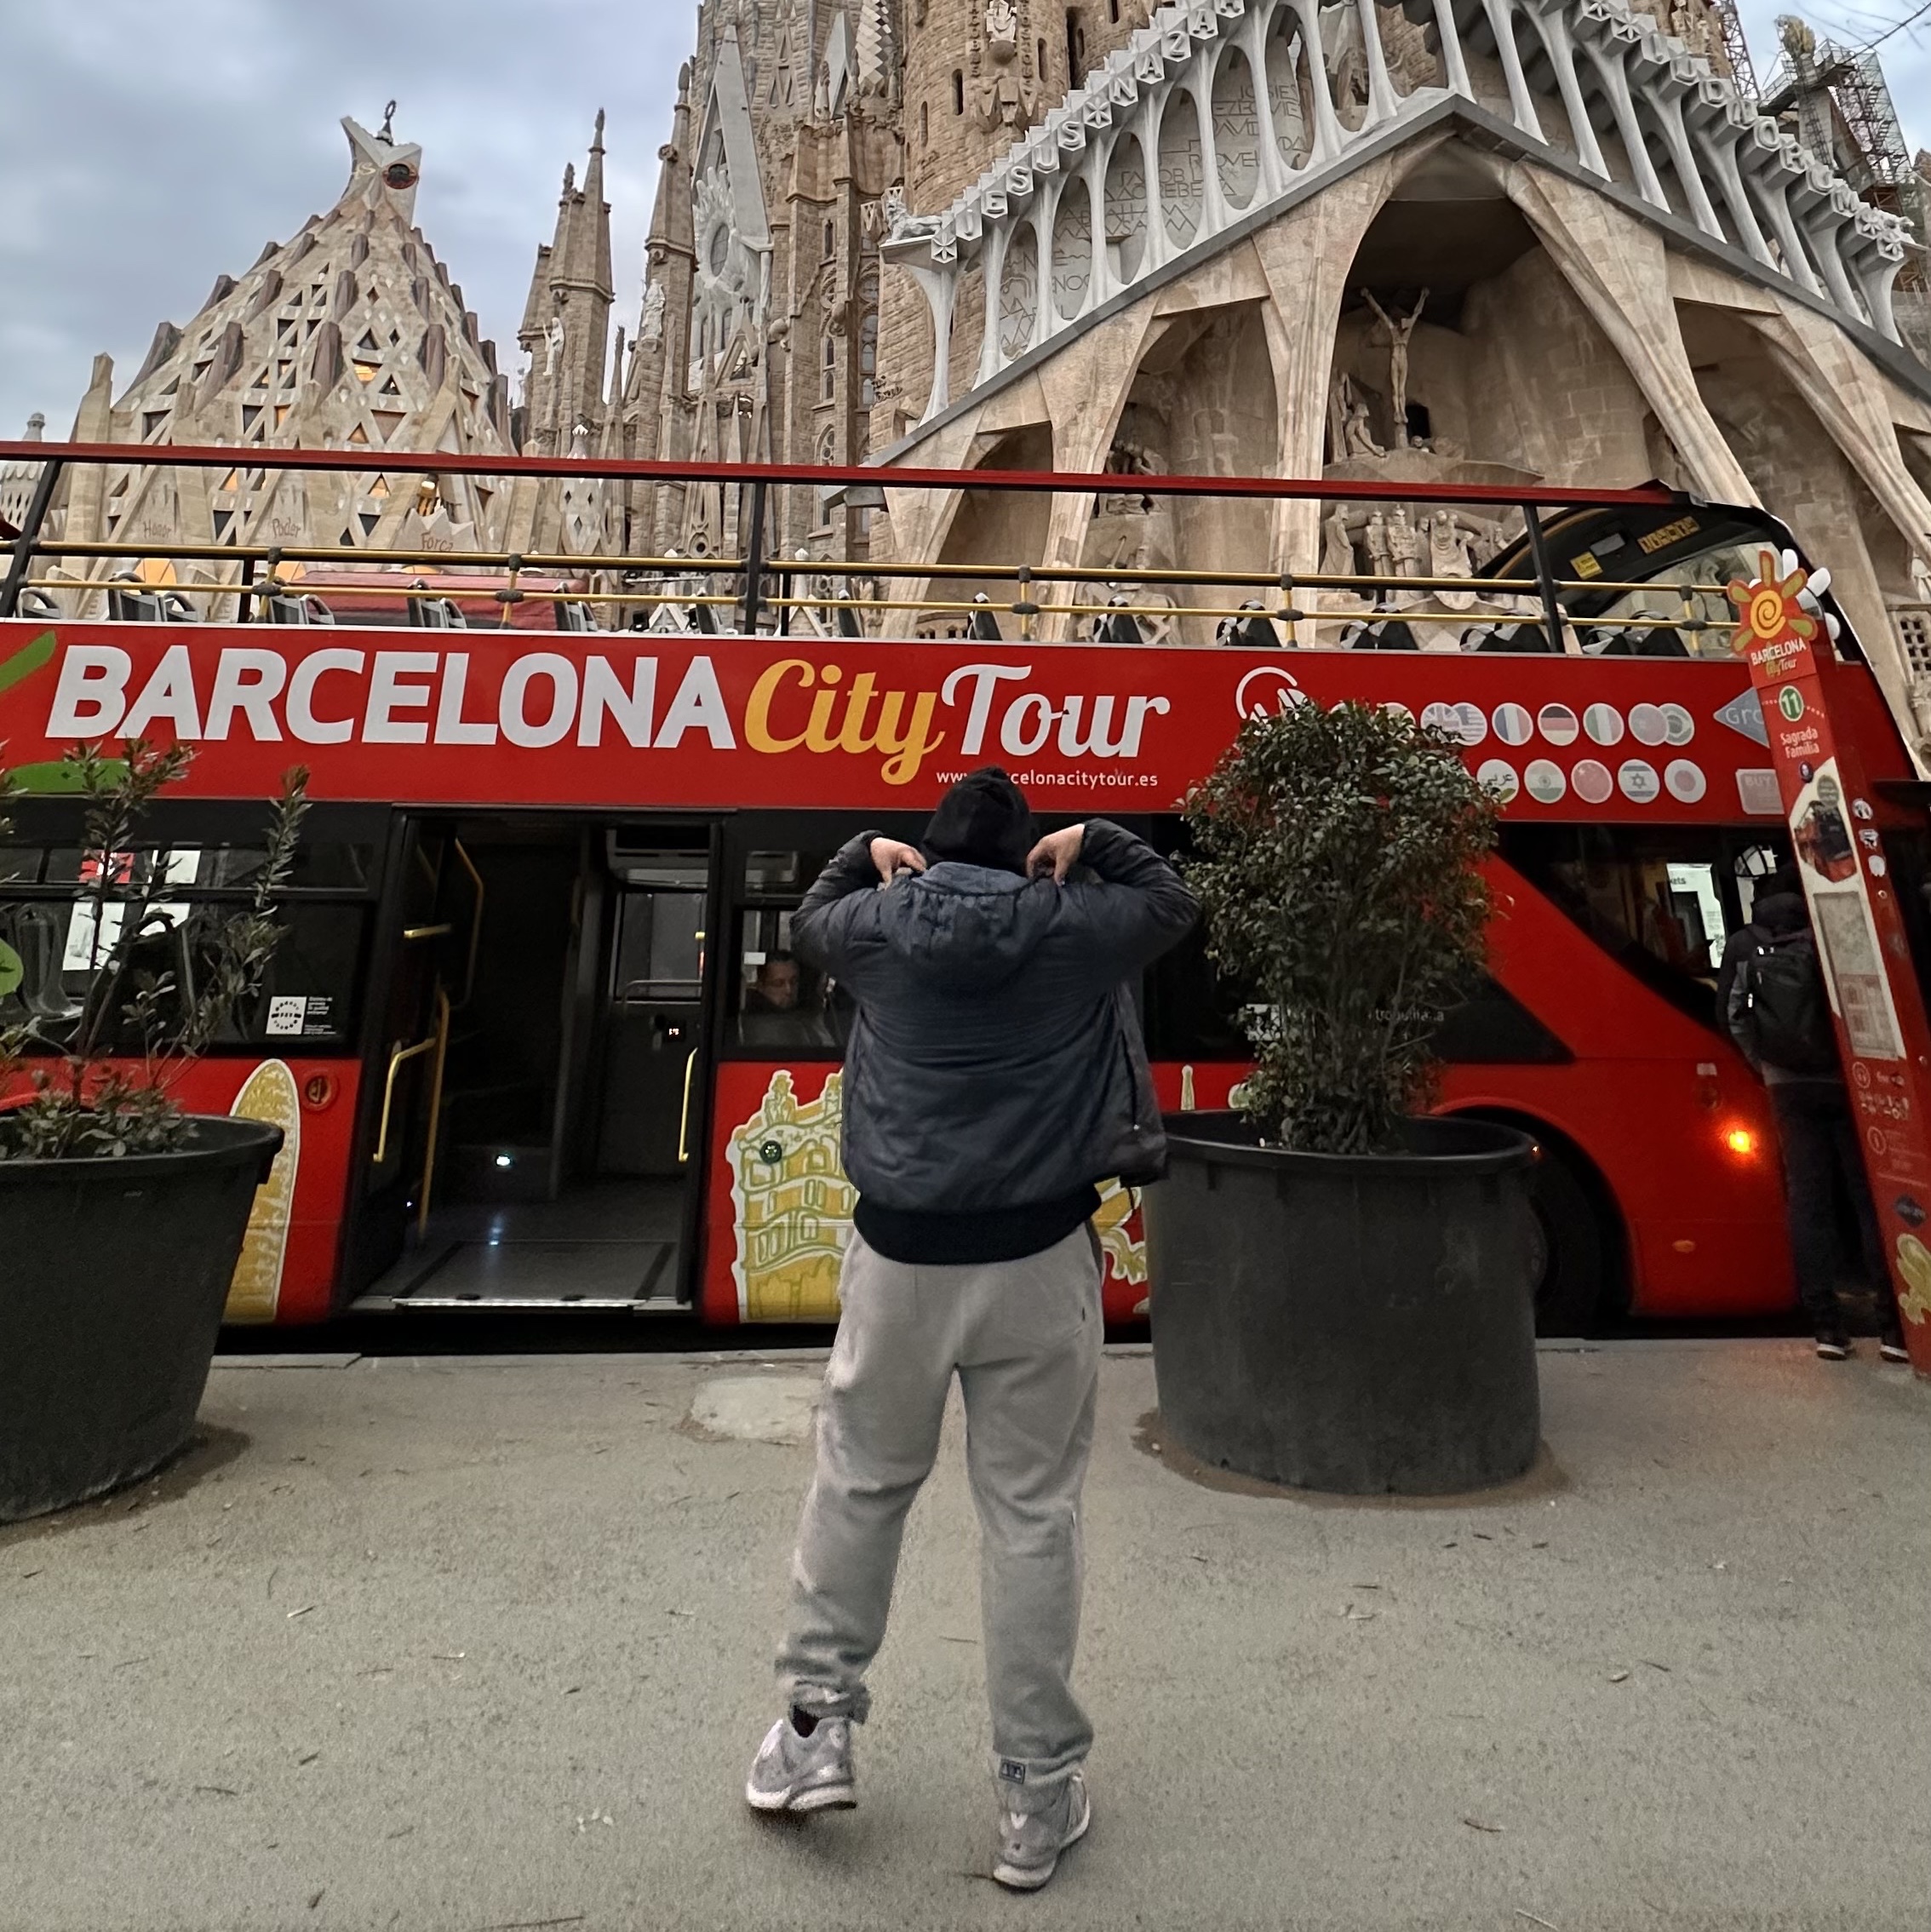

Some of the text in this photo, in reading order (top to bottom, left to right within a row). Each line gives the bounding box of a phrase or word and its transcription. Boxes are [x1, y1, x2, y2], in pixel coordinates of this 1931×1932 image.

[272, 518, 301, 539] Poder
[1751, 636, 1807, 667] BARCELONA
[1780, 656, 1797, 672] Tour
[45, 645, 1171, 785] BARCELONA City Tour
[1781, 692, 1801, 716] 11
[1780, 725, 1819, 747] Sagrada
